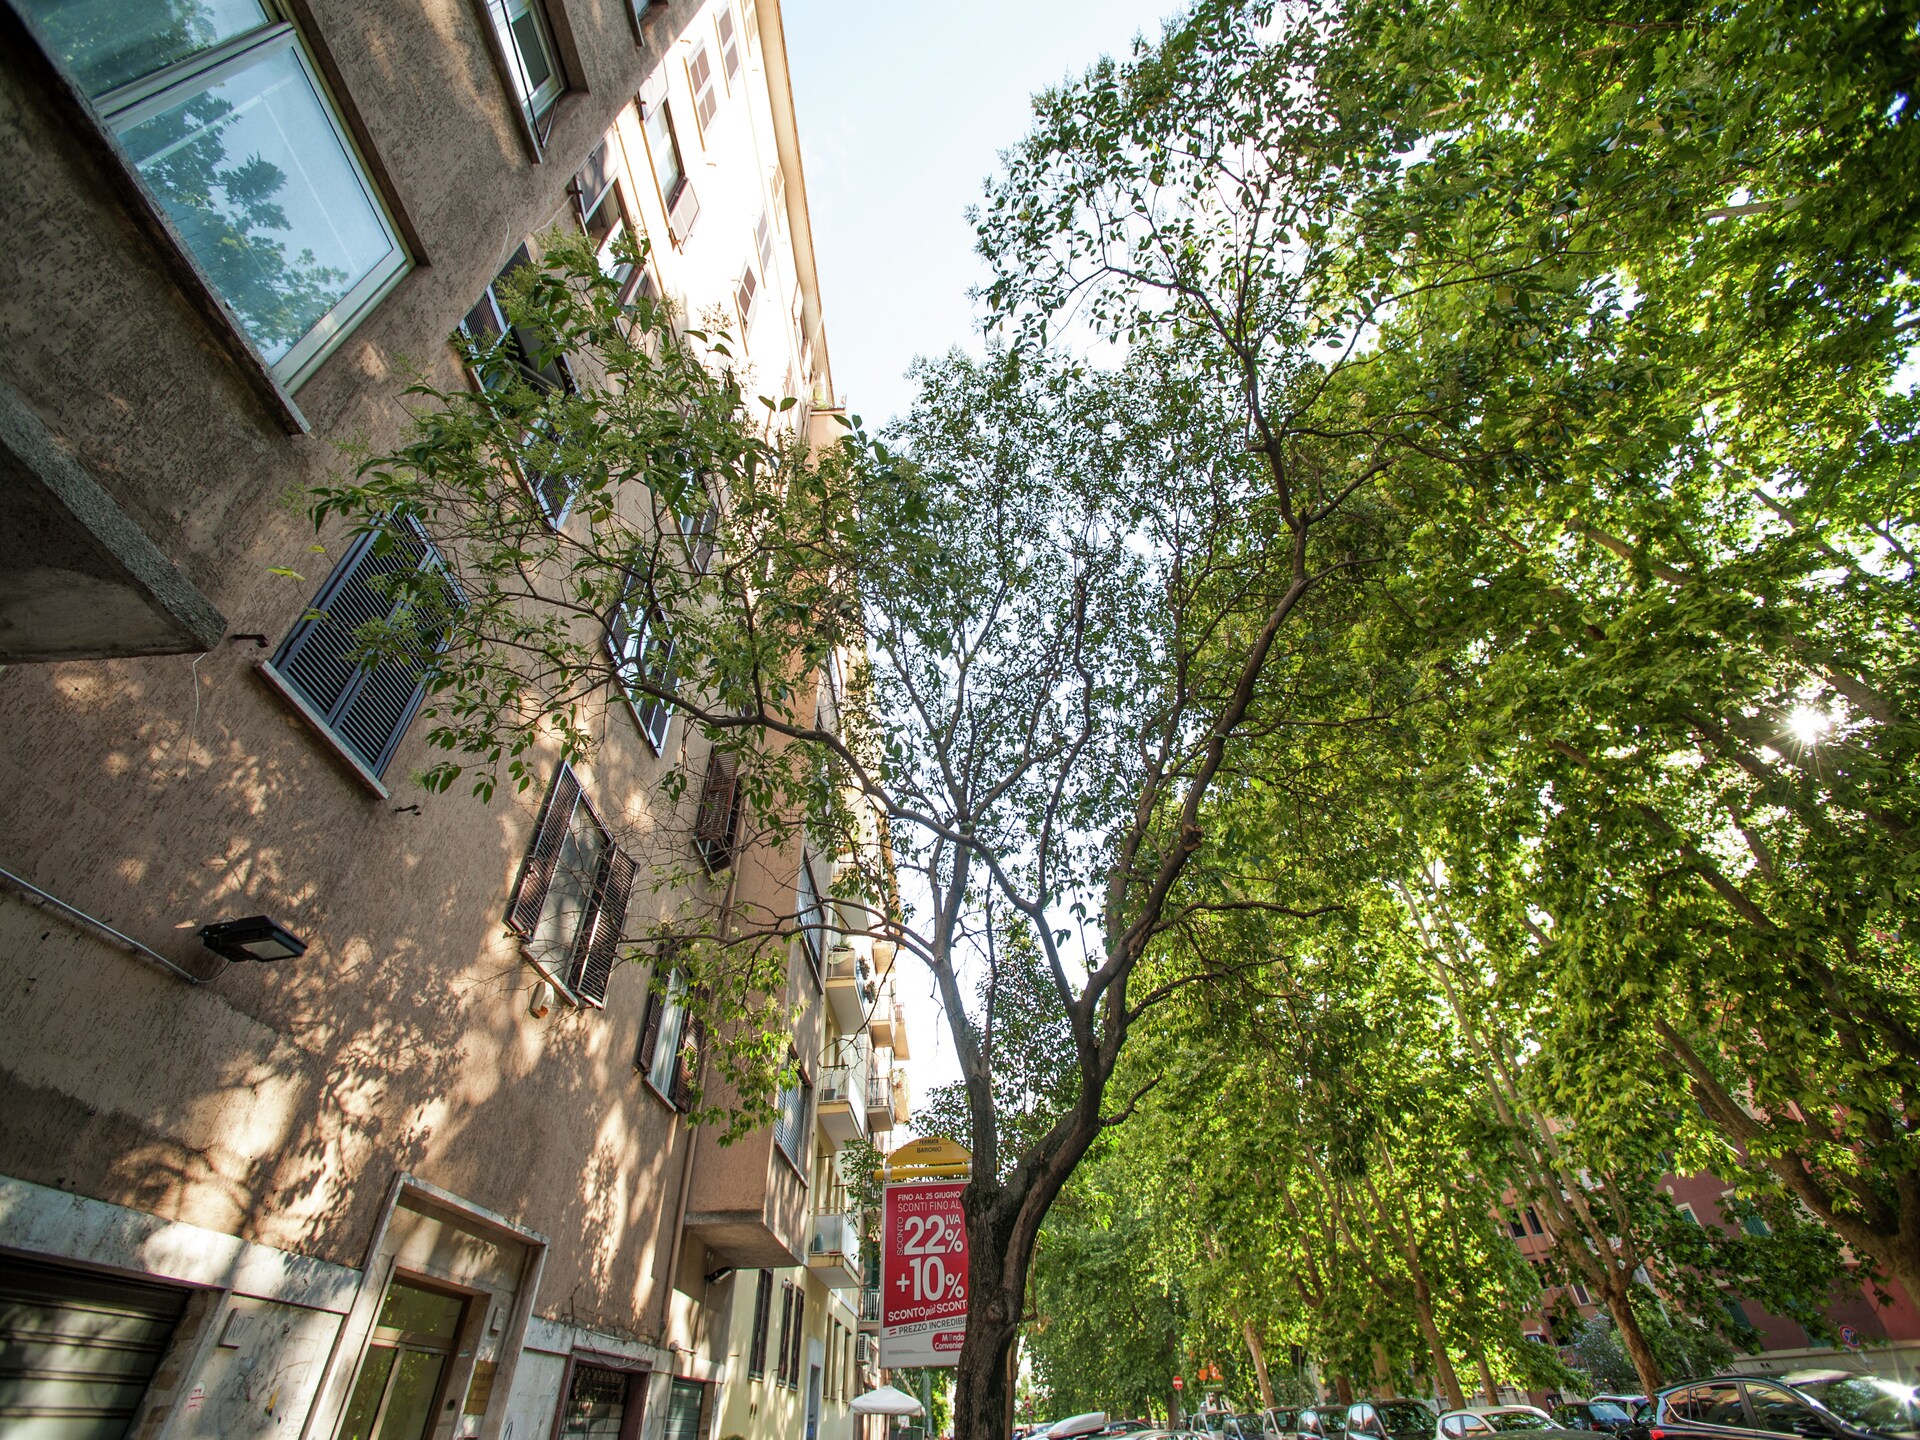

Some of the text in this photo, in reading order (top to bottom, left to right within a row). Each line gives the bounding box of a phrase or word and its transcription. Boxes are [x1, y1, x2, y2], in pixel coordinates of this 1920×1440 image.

[925, 1192, 933, 1200] 25
[934, 1191, 961, 1199] GIUGNO
[897, 1200, 961, 1213] SCONTI FINO AL
[946, 1214, 961, 1224] IVA
[904, 1214, 964, 1256] 22%
[896, 1255, 965, 1301] +10%
[888, 1307, 925, 1321] SCONTO
[936, 1300, 968, 1313] SCONT
[899, 1323, 927, 1334] PREZZO
